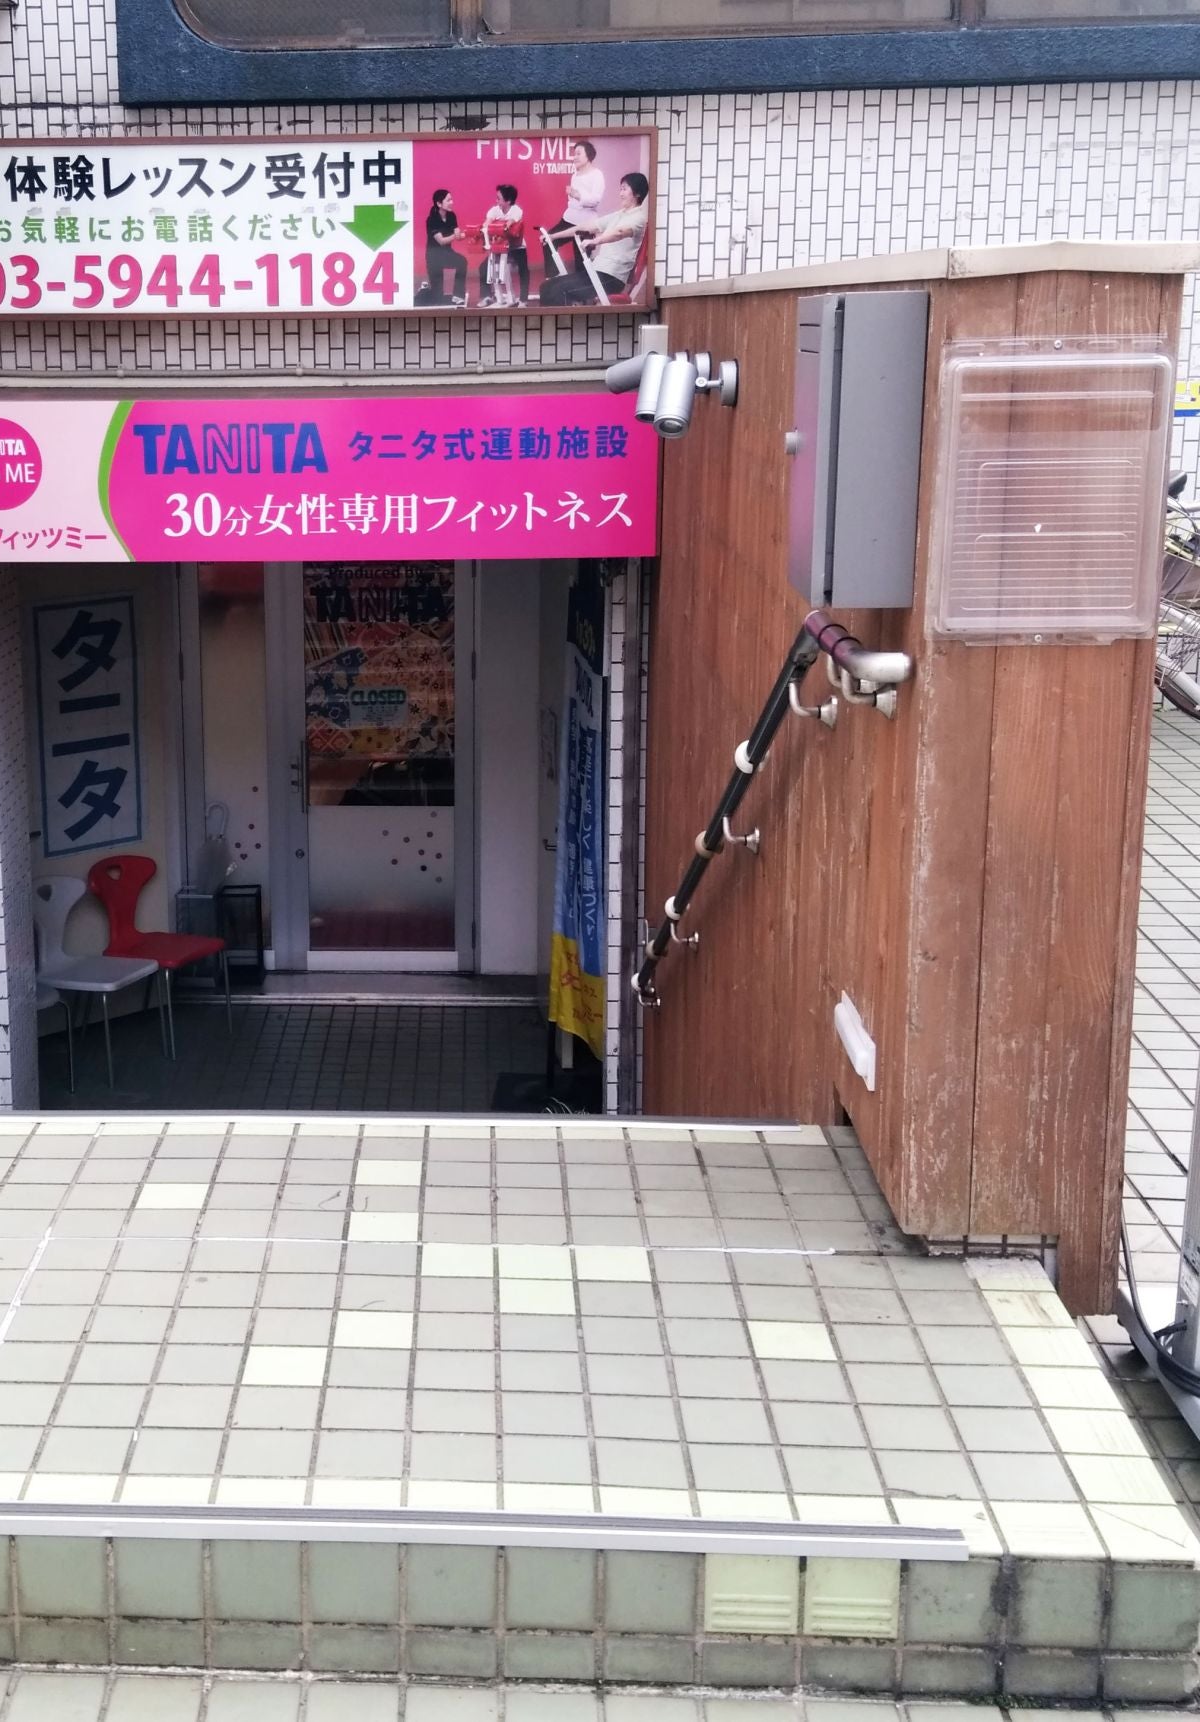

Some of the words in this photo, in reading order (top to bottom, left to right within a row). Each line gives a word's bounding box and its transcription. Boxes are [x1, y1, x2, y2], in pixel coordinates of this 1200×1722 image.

[476, 138, 532, 160] FITS
[533, 163, 545, 174] BY
[546, 162, 577, 174] TANITA
[132, 421, 329, 475] TANITA
[347, 424, 629, 463] タニタ式運動施設
[5, 462, 36, 484] ME
[162, 489, 634, 538] 30分女性専用フィットネス
[310, 586, 449, 622] TANITA
[351, 689, 407, 705] CLOSED
[51, 608, 130, 843] タニタ
